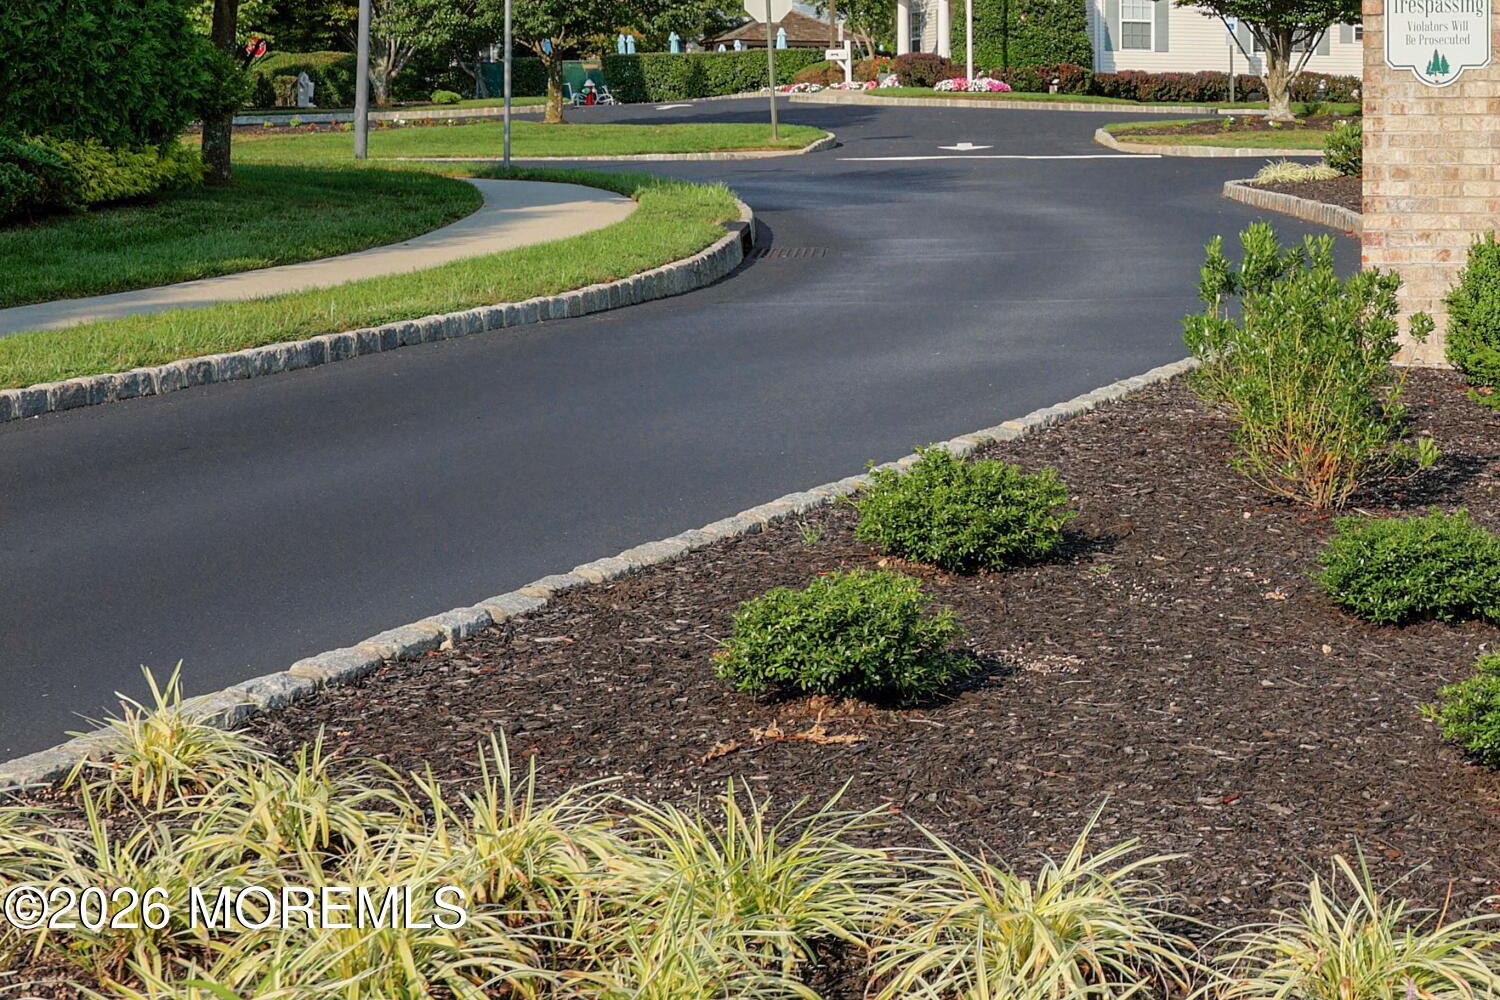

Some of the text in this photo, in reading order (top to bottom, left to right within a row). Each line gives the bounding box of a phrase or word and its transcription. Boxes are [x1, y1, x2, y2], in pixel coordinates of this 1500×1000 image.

[1407, 20, 1468, 32] Violators Will
[1405, 33, 1470, 45] Be Prosecuted
